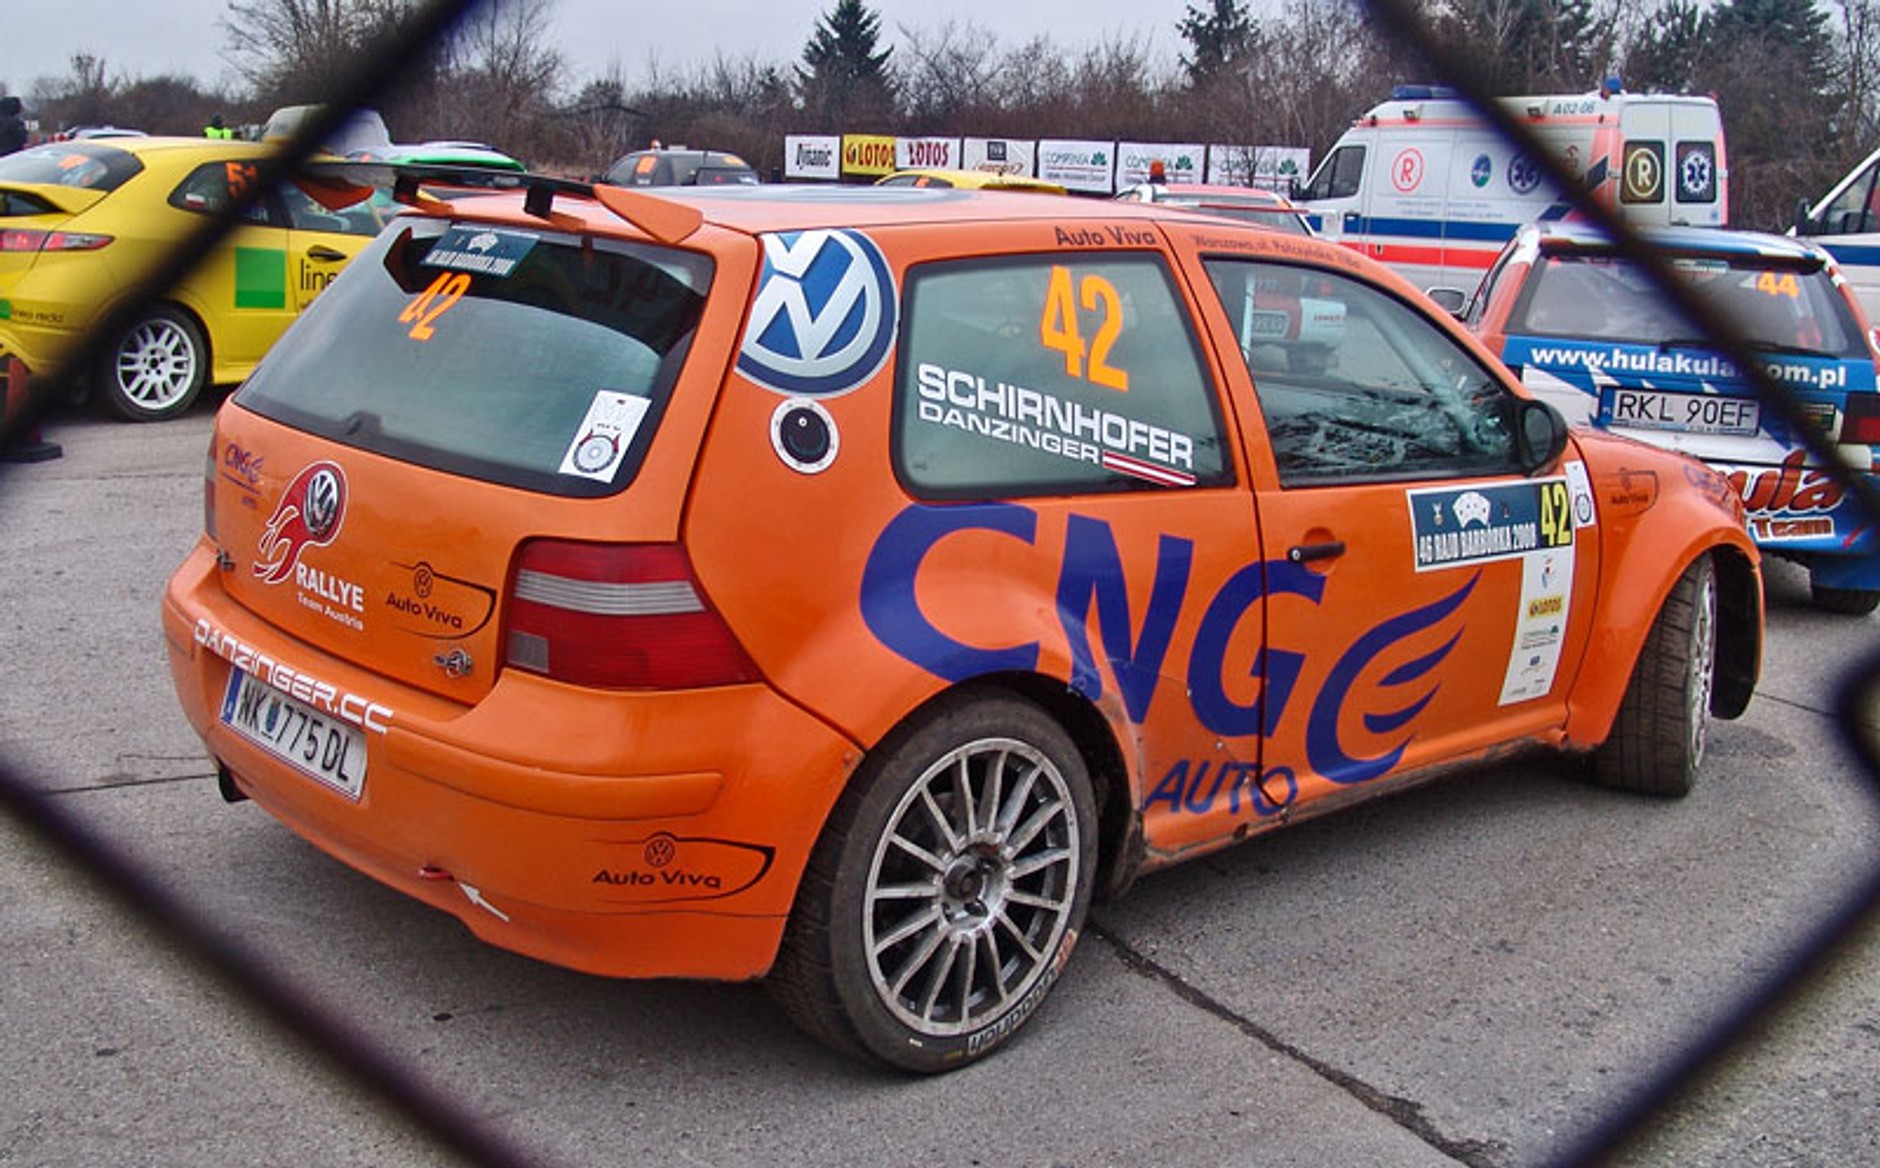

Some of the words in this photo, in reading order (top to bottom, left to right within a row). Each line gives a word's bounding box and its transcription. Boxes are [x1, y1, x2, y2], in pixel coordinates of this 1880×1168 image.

[907, 142, 950, 167] LOTOS
[1637, 157, 1651, 187] R
[1055, 226, 1105, 247] Auto
[1108, 228, 1158, 246] Viva
[1756, 270, 1800, 299] 44
[398, 272, 472, 341] 42
[1040, 264, 1129, 392] 42
[1531, 347, 1847, 389] www.hulakula.om.pl
[918, 363, 1195, 469] SCHIRNHOFER
[1617, 393, 1674, 423] RKL
[1686, 399, 1757, 428] 90EF
[918, 401, 1099, 465] DANZINGER
[1541, 483, 1572, 546] 42
[1752, 518, 1832, 538] Team
[296, 563, 364, 613] RALLYE
[297, 591, 323, 612] Team
[386, 592, 422, 616] Auto
[423, 604, 463, 629] Viva
[1144, 758, 1299, 818] AUTO
[592, 868, 655, 887] Auto
[663, 871, 722, 891] Viva
